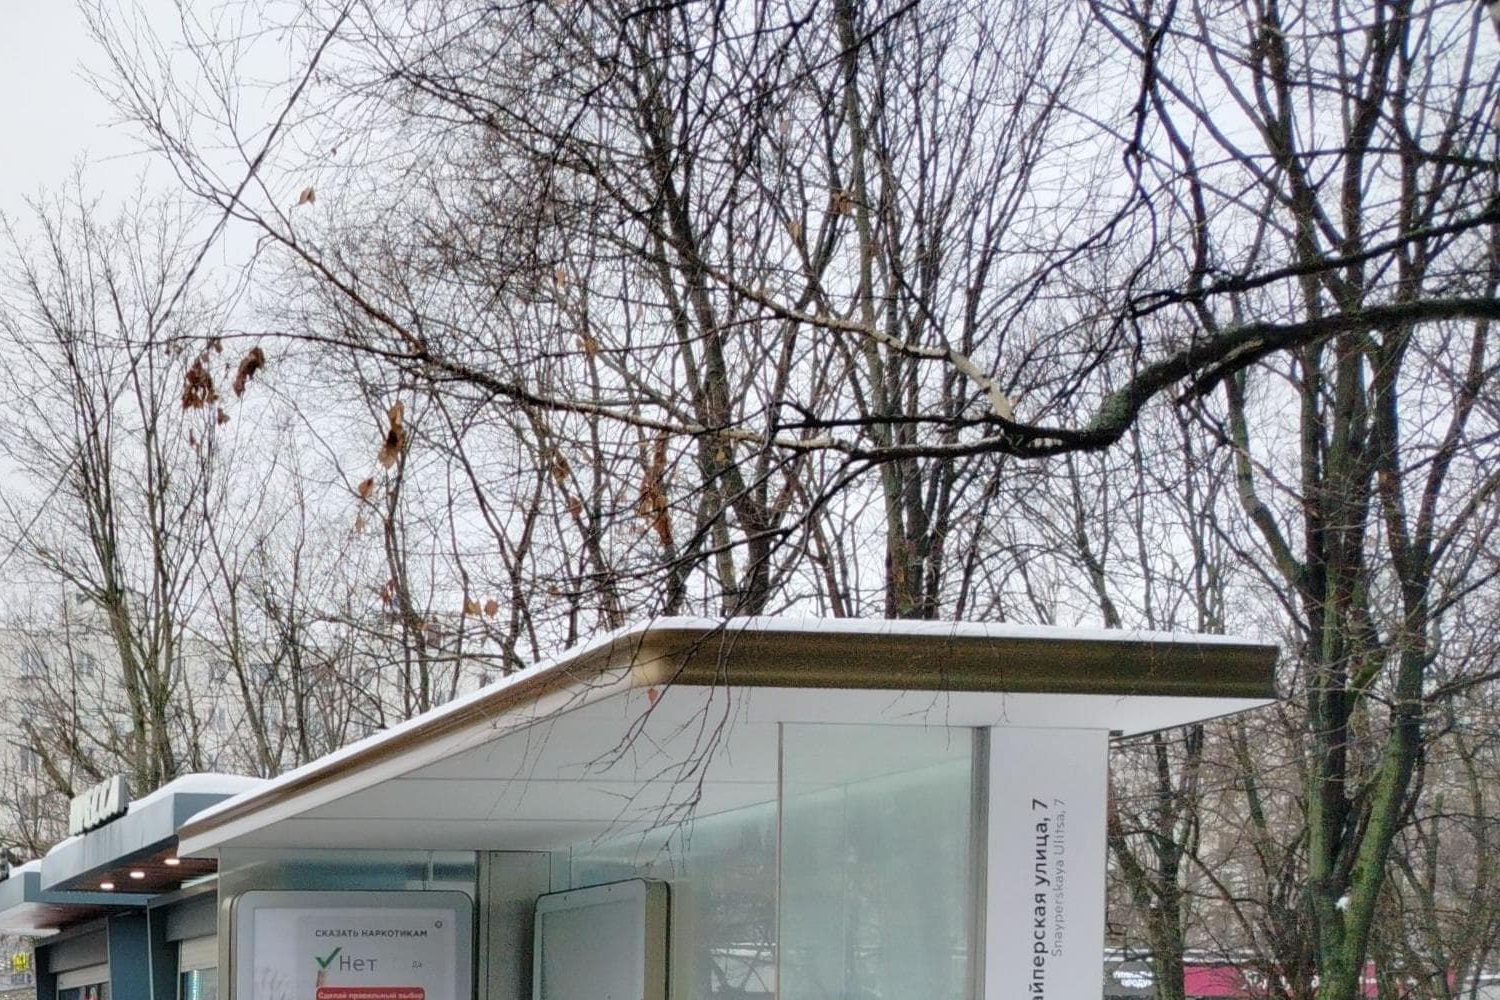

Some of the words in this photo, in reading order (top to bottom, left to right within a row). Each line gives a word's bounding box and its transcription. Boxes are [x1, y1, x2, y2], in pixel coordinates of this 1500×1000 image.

[1031, 798, 1048, 811] 7
[1053, 798, 1066, 806] 7
[1035, 816, 1051, 887] улица,
[1051, 859, 1066, 957] Snayperskaya
[315, 929, 359, 938] СКАЗАТЬ
[361, 929, 428, 938] НАРКОТИКАМ
[339, 954, 378, 972] Нет
[411, 960, 423, 969] Да
